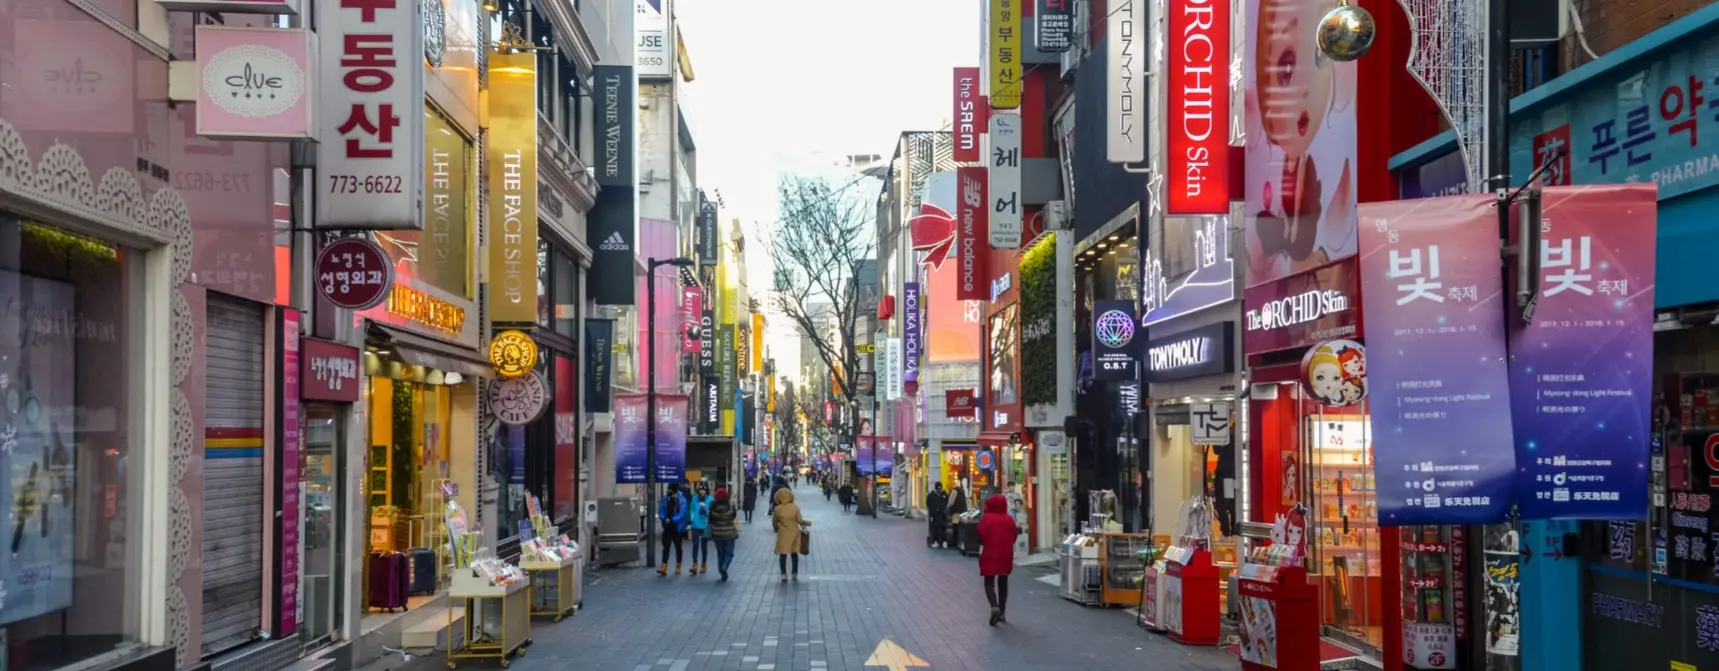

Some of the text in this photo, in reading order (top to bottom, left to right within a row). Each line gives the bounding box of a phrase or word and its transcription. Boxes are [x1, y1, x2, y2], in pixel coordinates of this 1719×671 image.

[998, 27, 1013, 84] 부동산
[1121, 2, 1132, 143] TONYMOLY
[606, 74, 620, 177] TEENIE WEENIE
[960, 77, 973, 150] the SAEM
[1588, 75, 1719, 175] 푸른약
[330, 174, 402, 194] 773-6622
[993, 147, 1018, 215] 헤어
[1187, 147, 1208, 198] Skin
[504, 150, 522, 304] THE FACE SHOP
[599, 242, 630, 251] adidas
[963, 208, 973, 235] new
[320, 270, 383, 294] 성형외과
[963, 238, 975, 292] balance
[1389, 244, 1445, 306] 빛
[1448, 285, 1478, 302] 축제
[1540, 236, 1594, 297] 빛
[1597, 279, 1628, 296] 축제
[906, 289, 917, 373] HOLIKA HOLIKA
[1261, 290, 1321, 331] ORCHID
[1322, 289, 1348, 314] Skin
[701, 316, 712, 367] GUESS
[1149, 337, 1200, 371] TONYMOLY
[709, 383, 718, 422] ARITAUM
